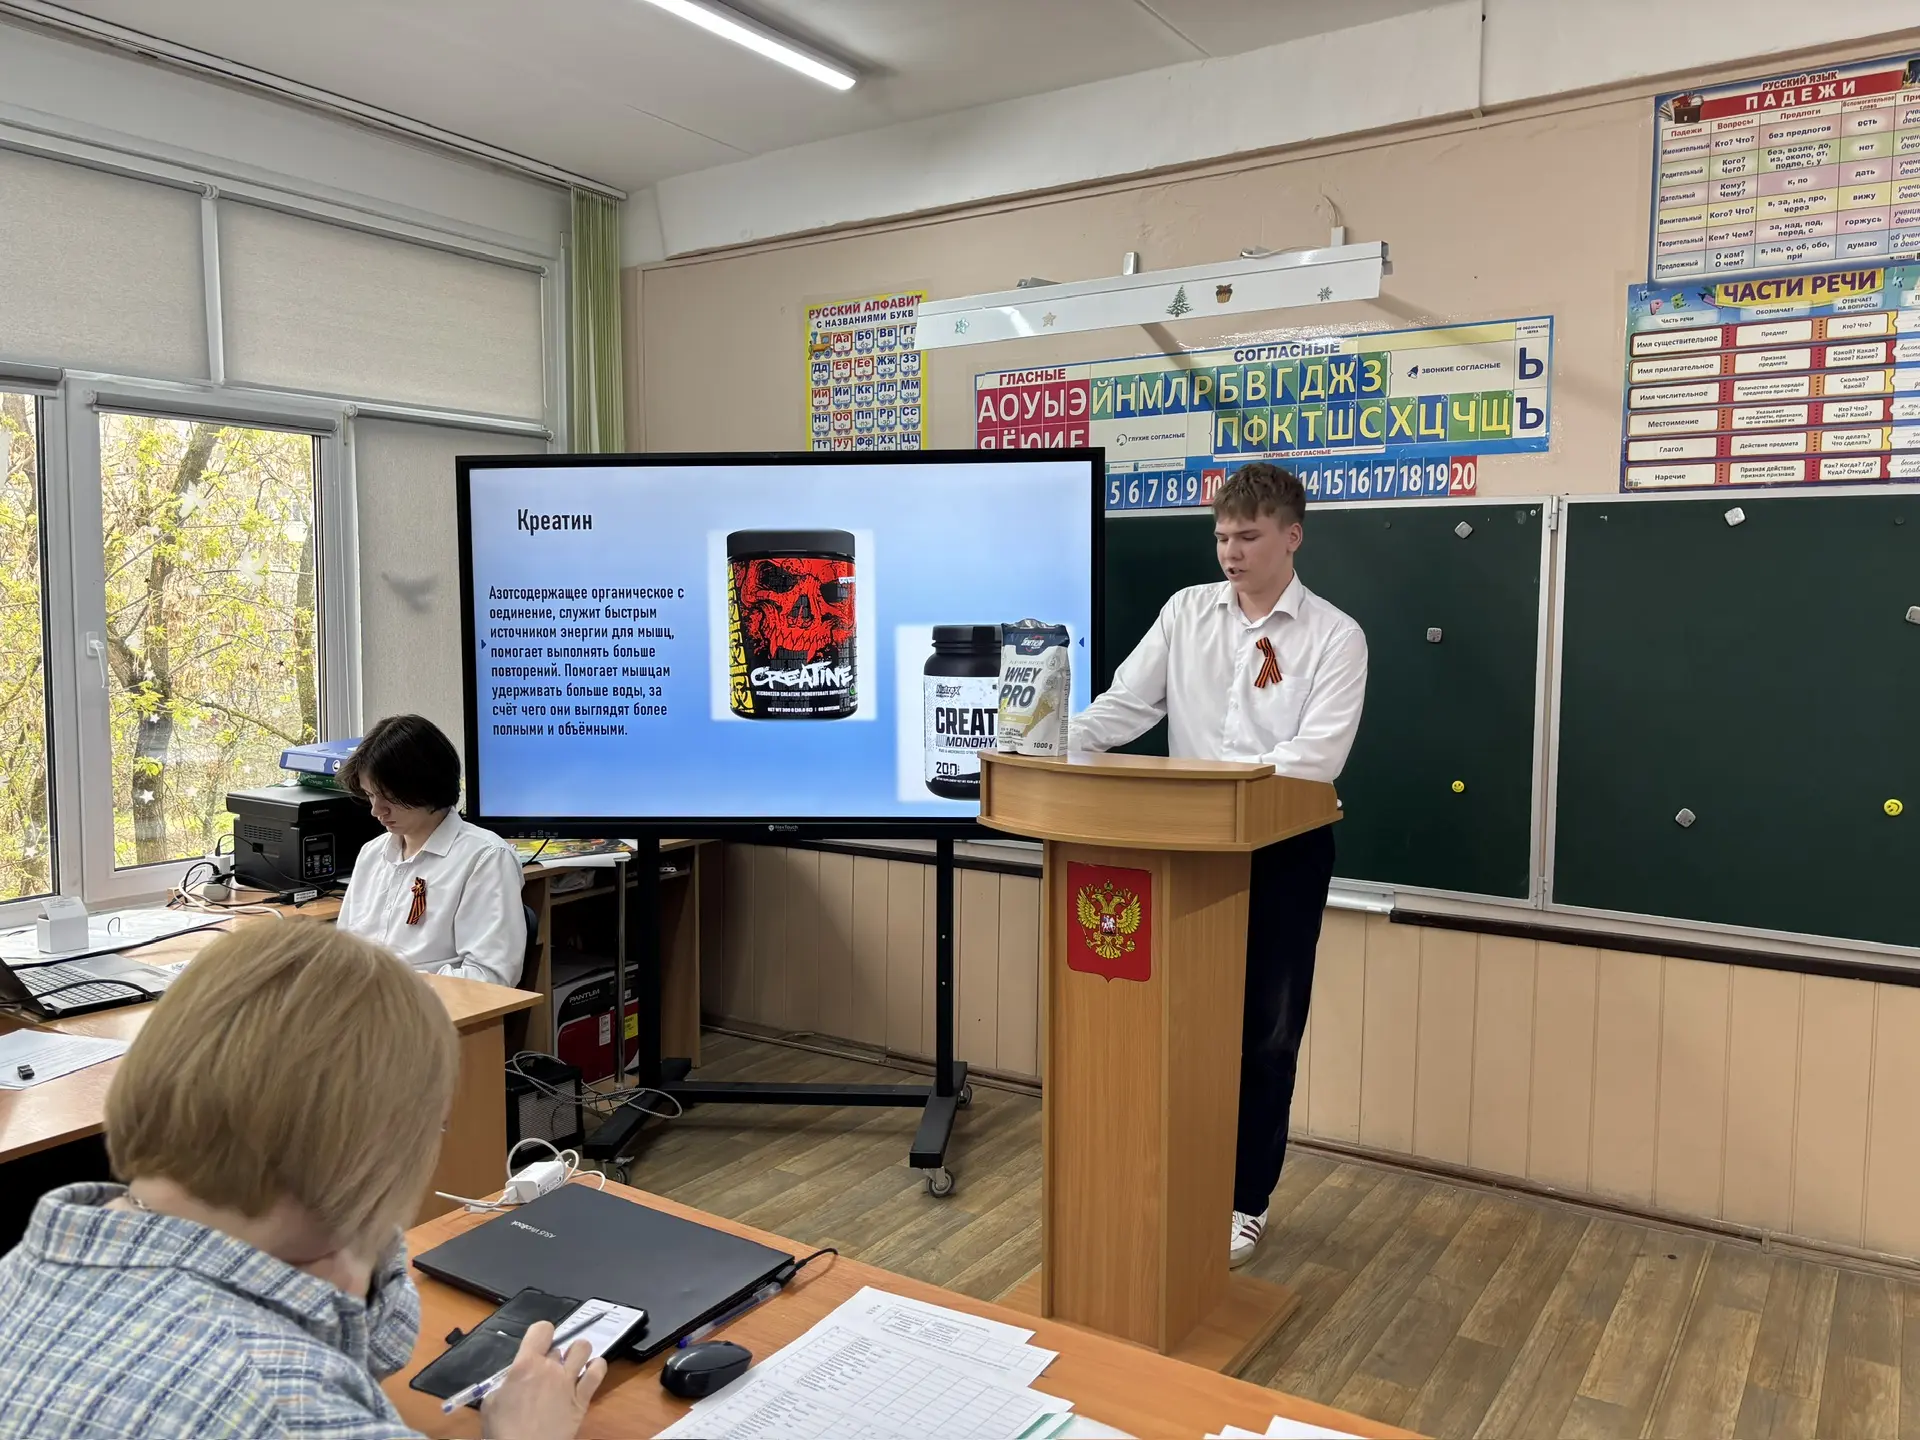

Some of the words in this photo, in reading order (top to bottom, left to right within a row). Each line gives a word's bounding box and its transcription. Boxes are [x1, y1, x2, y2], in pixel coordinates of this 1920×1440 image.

[1763, 75, 1806, 90] РУССКИЙ
[1809, 71, 1837, 83] ЯЗЫК
[1746, 80, 1856, 111] ПАДЕЖИ
[1780, 108, 1820, 120] Предлоги
[1718, 119, 1753, 129] Вопросы
[1858, 119, 1877, 127] есть
[1671, 128, 1702, 137] Падежи
[1787, 126, 1831, 138] предлогов
[1715, 139, 1733, 147] Кто?
[1736, 136, 1754, 144] Что?
[1663, 143, 1710, 155] Именительный
[1722, 156, 1746, 166] Кого?
[1661, 167, 1703, 179] Родительный
[1722, 165, 1745, 174] Чего?
[1855, 170, 1875, 178] дать
[1720, 181, 1745, 190] Кому?
[1661, 192, 1695, 202] Дательный
[1720, 189, 1745, 198] Чему?
[1710, 210, 1732, 219] Кого?
[1735, 207, 1754, 215] Что?
[1660, 214, 1701, 225] Винительный
[1845, 216, 1881, 226] горжусь
[1659, 236, 1703, 247] Творительный
[1709, 233, 1729, 241] Кем?
[1732, 230, 1753, 238] Чем?
[1847, 241, 1877, 250] думаю
[1657, 261, 1698, 271] Предложный
[1724, 259, 1744, 267] чем?
[1724, 278, 1803, 303] ЧАСТИ
[1812, 271, 1877, 294] РЕЧИ
[1842, 296, 1872, 304] ОТВЕЧАЕТ
[1848, 302, 1878, 310] ВОПРОСЫ
[809, 302, 860, 319] РУССКИЙ
[864, 295, 922, 311] АЛФАВИТ
[825, 313, 886, 328] НАЗВАНИЯМИ
[890, 310, 914, 319] БУКВ
[836, 334, 849, 343] Аа
[858, 332, 871, 340] Бб
[880, 328, 893, 338] Вв
[1654, 335, 1718, 347] существительное
[1234, 344, 1340, 362] СОГЛАСНЫЕ
[813, 364, 828, 373] Дд
[836, 361, 848, 370] Ее
[878, 356, 895, 365] Жж
[903, 354, 916, 362] Зз
[1422, 366, 1454, 374] ЗВОНКИЕ
[1456, 362, 1500, 371] СОГЛАСНЫЕ
[1518, 347, 1544, 380] Ь
[1655, 363, 1714, 373] прилагательное
[999, 369, 1066, 386] ГЛАСНЫЕ
[814, 389, 828, 398] Ии
[858, 386, 870, 394] Кк
[880, 383, 894, 392] Лл
[902, 381, 918, 390] Мм
[1656, 391, 1708, 400] числительное
[814, 414, 828, 422] Нн
[835, 413, 849, 421] Оо
[857, 411, 871, 420] Пп
[880, 409, 893, 419] Рр
[902, 407, 916, 416] Сс
[1515, 397, 1544, 430] Ъ
[1648, 419, 1699, 428] Местоимение
[816, 440, 827, 448] Тт
[857, 438, 872, 447] Фф
[880, 435, 893, 444] Хх
[902, 434, 918, 443] Цц
[1151, 432, 1185, 440] СОГЛАСНЫЕ
[1263, 451, 1289, 459] ПАРНЫЕ
[1292, 449, 1332, 457] СОГЛАСНЫЕ
[1110, 481, 1120, 504] 5
[1128, 479, 1139, 503] 6
[1148, 479, 1158, 503] 7
[1166, 477, 1178, 502] 8
[1186, 477, 1198, 501] 9
[1299, 471, 1319, 494] 14
[1324, 469, 1343, 495] 15
[1349, 467, 1369, 494] 16
[1374, 466, 1395, 492] 17
[1400, 465, 1421, 492] 18
[1426, 463, 1448, 491] 19
[1451, 462, 1476, 490] 20
[517, 508, 593, 536] Креатин
[489, 586, 588, 603] Азотсодержащее
[592, 588, 673, 602] органическое
[678, 588, 684, 599] с
[490, 608, 556, 621] оединение,
[559, 608, 600, 621] служит
[605, 605, 657, 621] быстрым
[490, 627, 557, 638] источником
[561, 627, 608, 642] энергии
[612, 627, 634, 640] для
[638, 627, 674, 640] мышц,
[491, 647, 543, 658] помогает
[547, 647, 609, 658] выполнять
[613, 644, 656, 657] больше
[492, 663, 561, 680] повторений.
[564, 663, 617, 677] Помогает
[622, 666, 670, 679] мышцам
[751, 661, 853, 689] CREATINE
[1005, 667, 1042, 683] WHEY
[492, 686, 562, 699] удерживать
[566, 683, 609, 697] больше
[613, 685, 646, 698] воды,
[649, 686, 662, 697] за
[1000, 685, 1035, 707] PRO
[493, 702, 517, 716] счёт
[522, 705, 546, 716] чего
[550, 705, 570, 716] они
[574, 705, 629, 718] выглядят
[633, 702, 667, 716] более
[493, 723, 543, 736] полными
[547, 724, 553, 735] и
[558, 722, 628, 736] объёмными.
[946, 737, 997, 748] MONOHY
